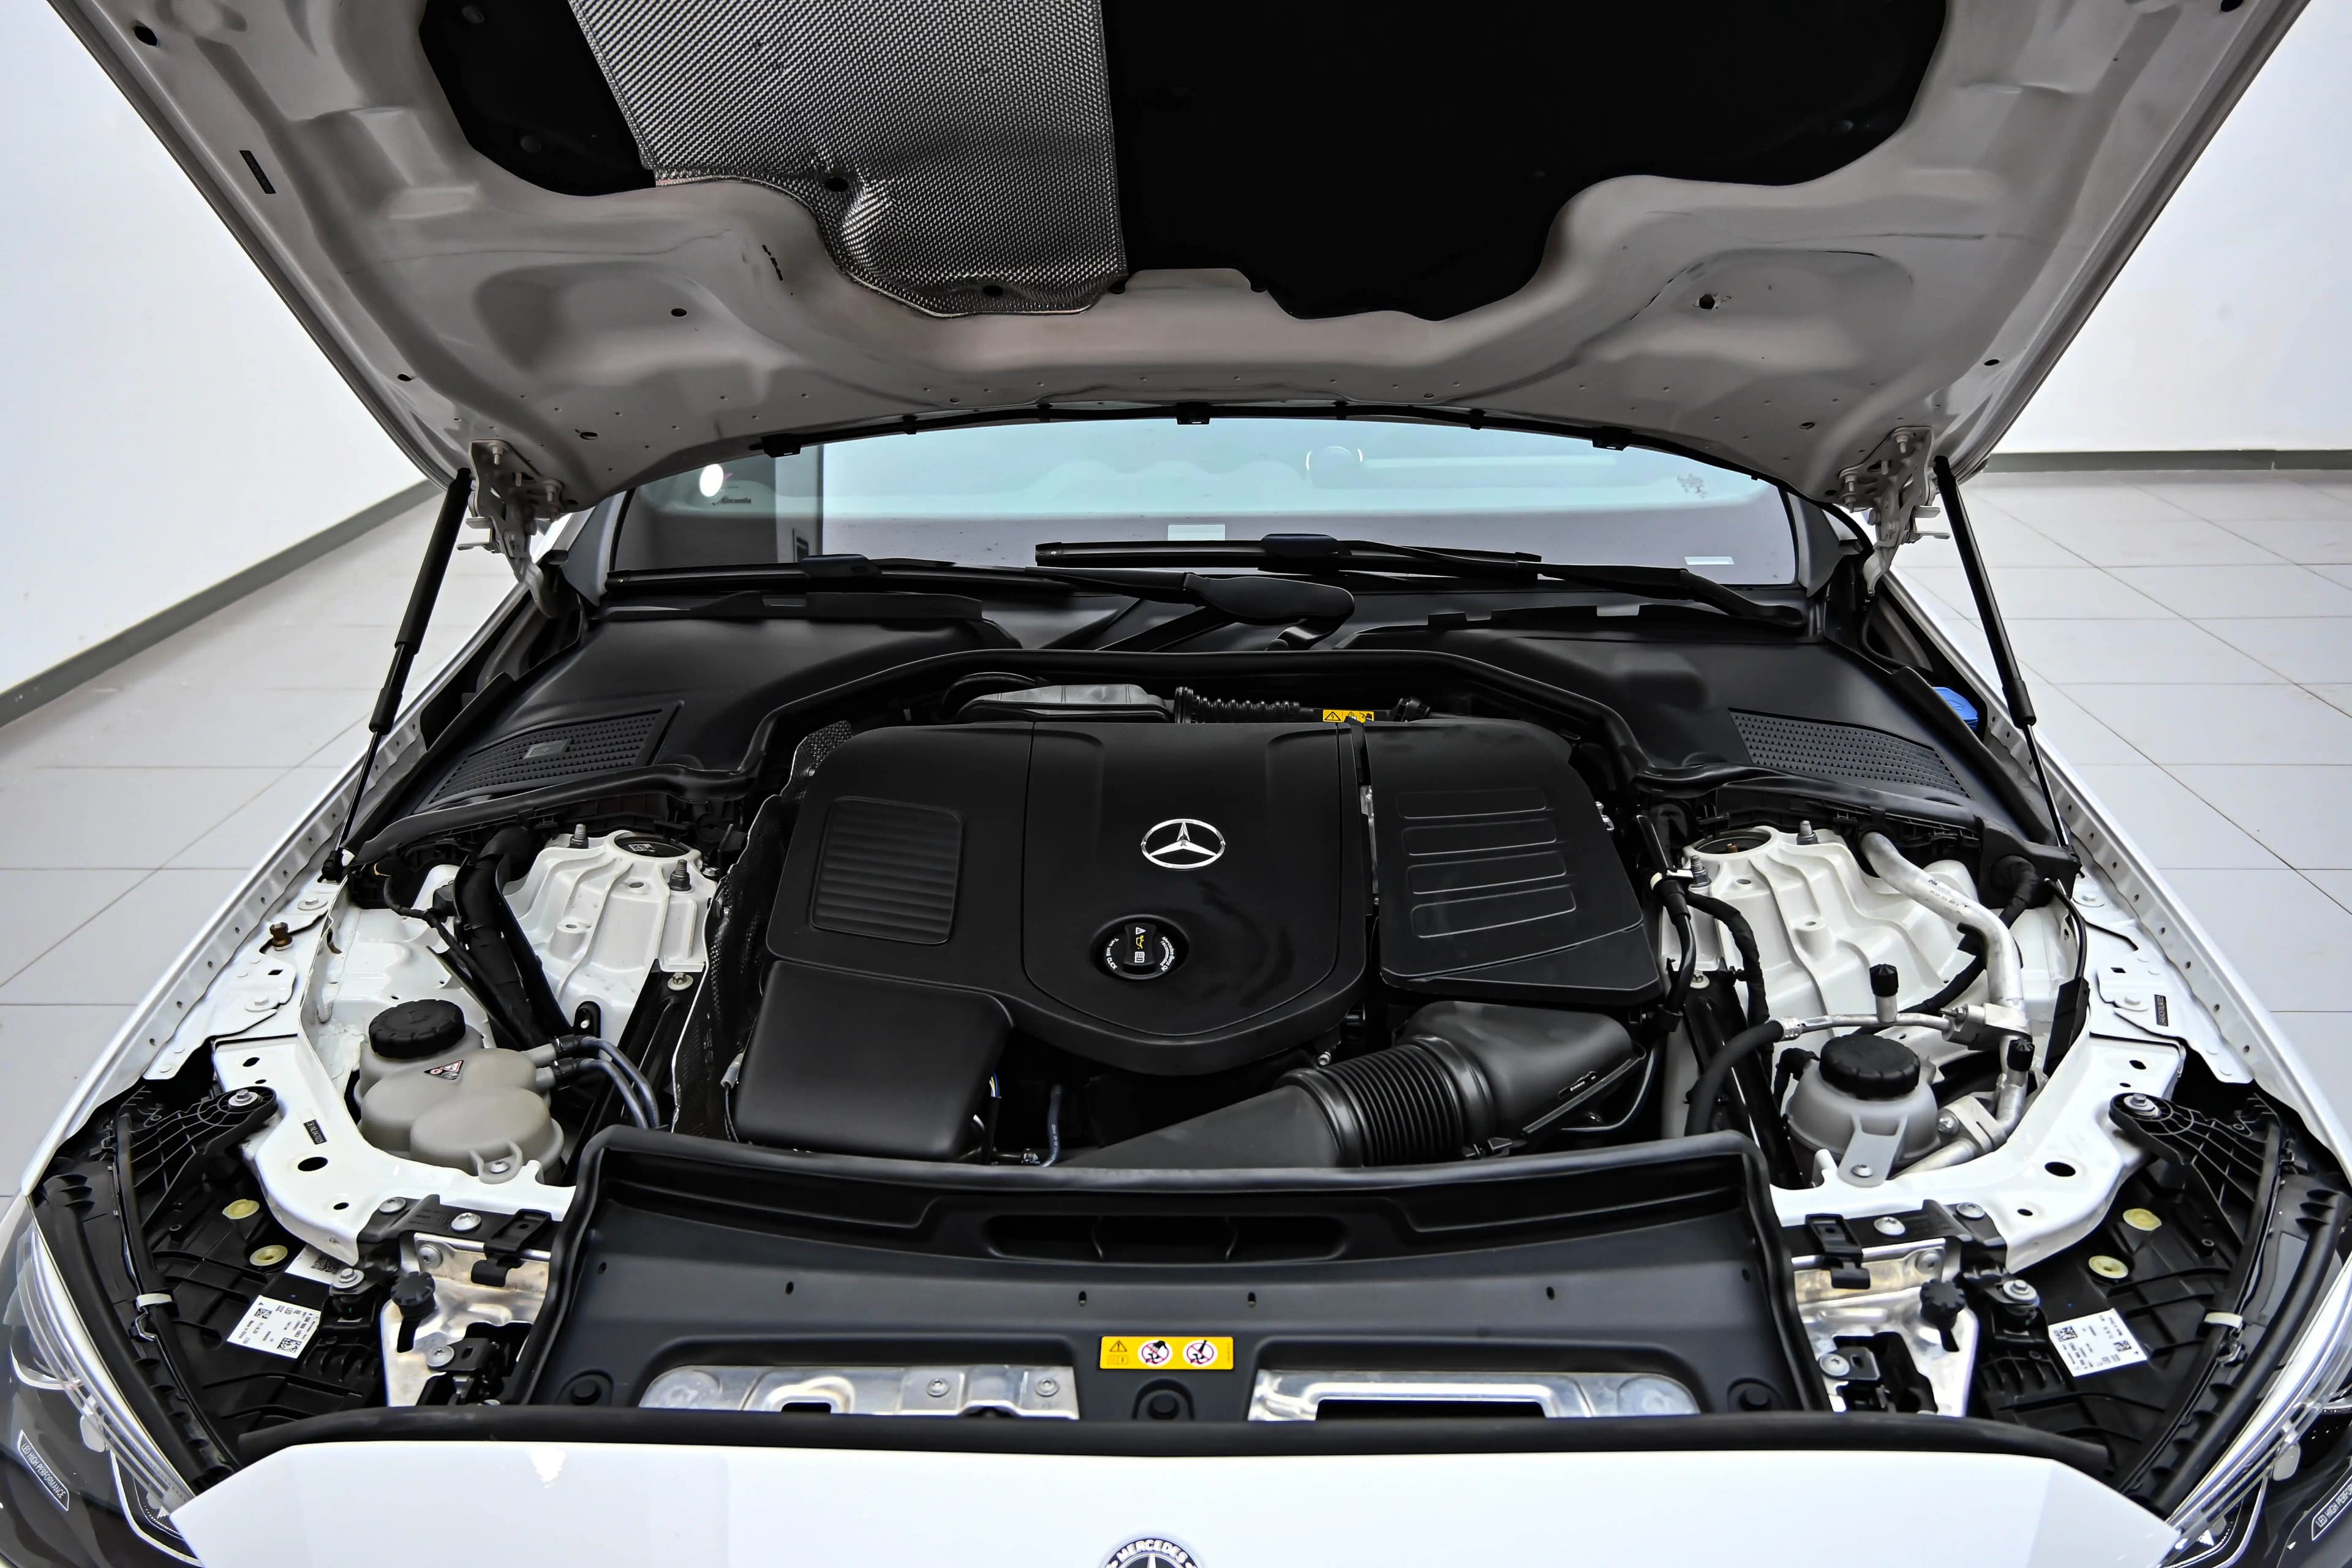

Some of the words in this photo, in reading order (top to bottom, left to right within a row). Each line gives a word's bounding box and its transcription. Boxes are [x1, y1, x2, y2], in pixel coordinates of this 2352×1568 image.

[1106, 957, 1118, 970] CLICK
[21, 1442, 31, 1455] LED
[26, 1451, 40, 1467] HIGH
[36, 1462, 66, 1499] PERFORMANCE
[2315, 1513, 2328, 1528] LED
[2324, 1502, 2340, 1519] HIGH
[1116, 1539, 1189, 1563] MERCEDES
